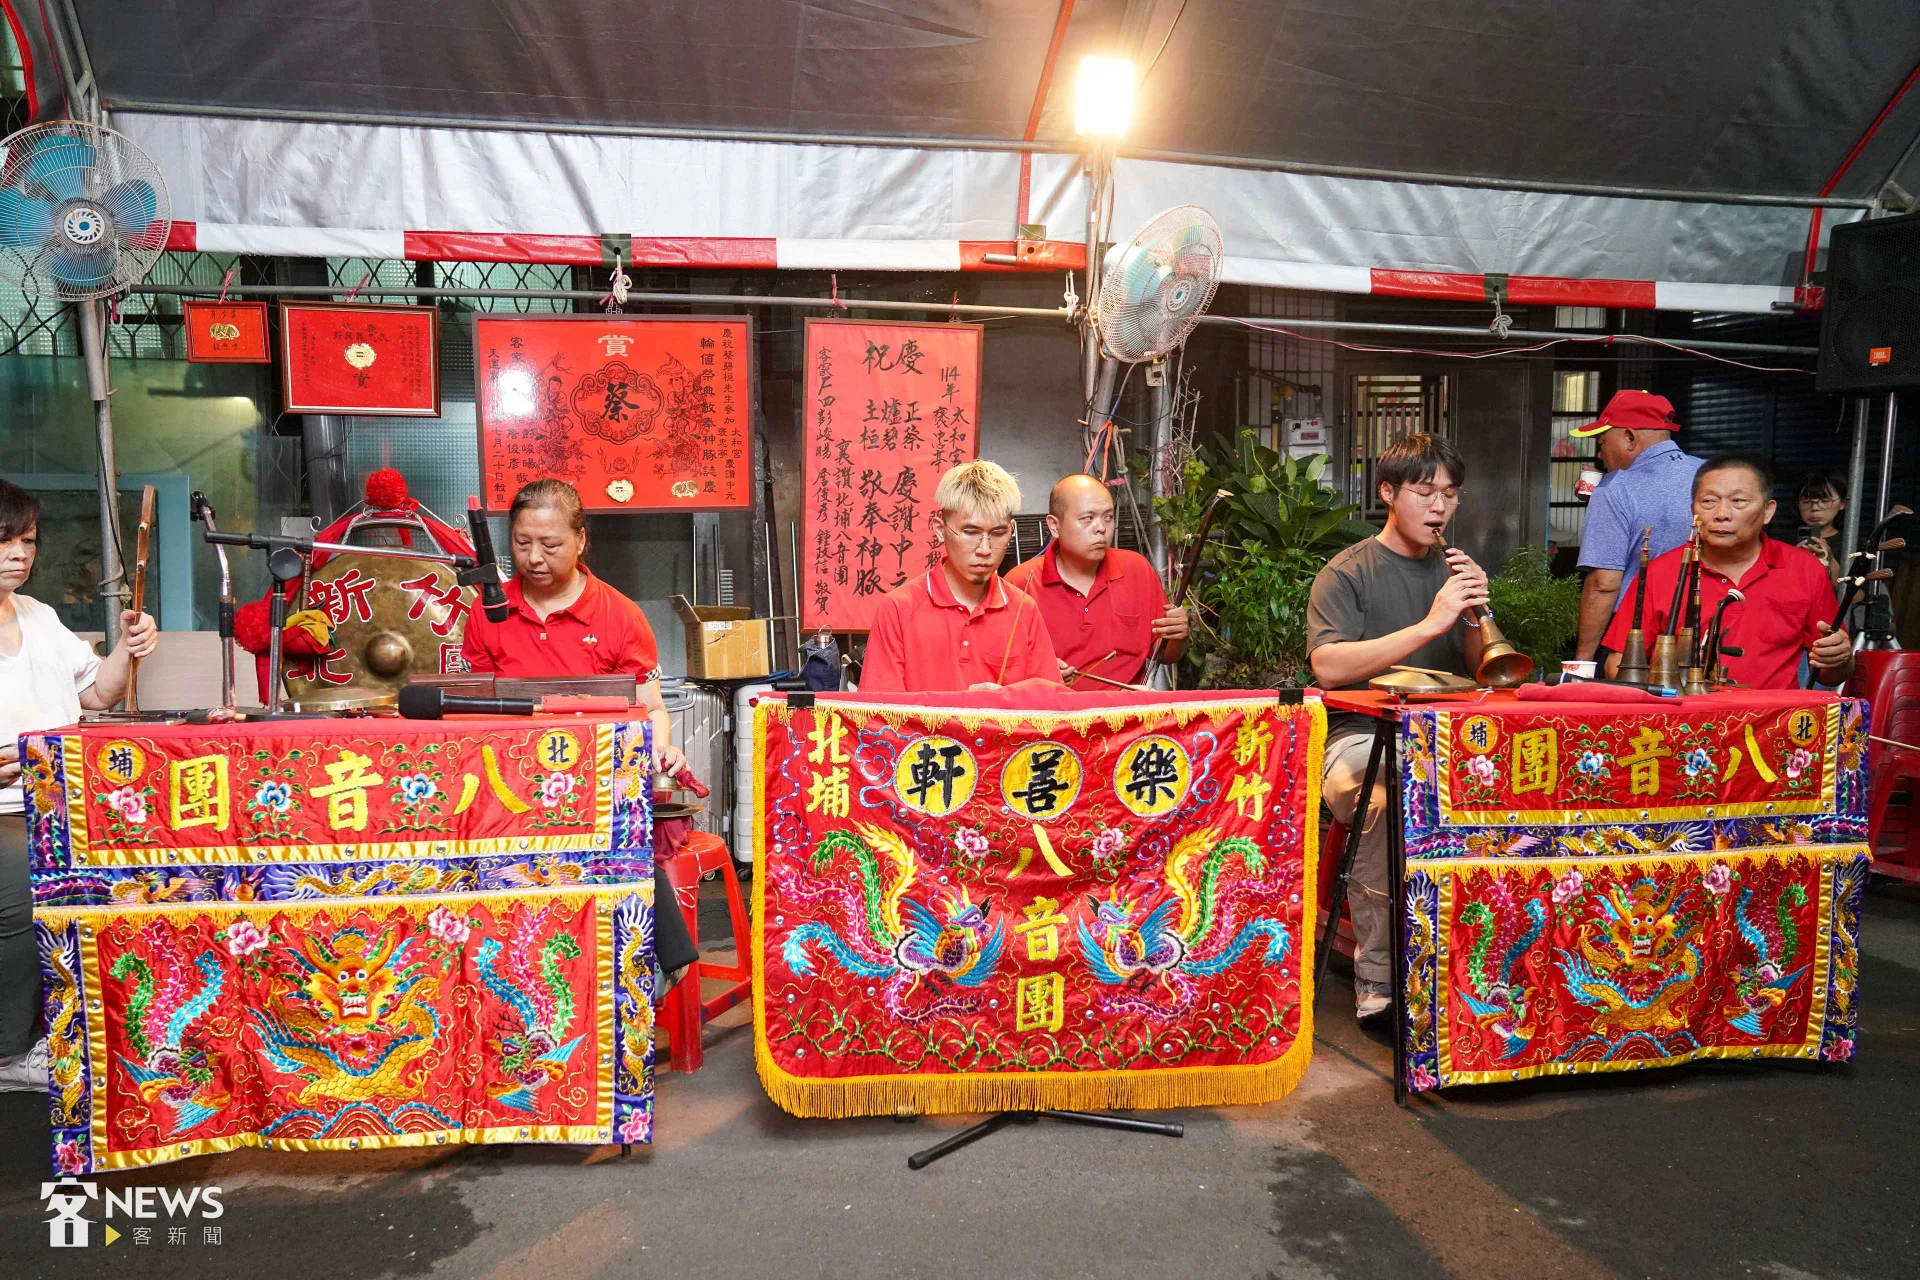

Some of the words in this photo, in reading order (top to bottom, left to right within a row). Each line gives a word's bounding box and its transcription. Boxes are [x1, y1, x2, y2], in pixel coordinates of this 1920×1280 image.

[598, 335, 635, 357] 賞
[861, 339, 926, 375] 慶祝
[602, 380, 640, 424] 蔡
[1467, 719, 1489, 749] 埔
[1796, 714, 1813, 742] 北
[107, 747, 134, 778] 埔
[546, 735, 570, 764] 北
[807, 713, 852, 819] 北埔
[904, 740, 1180, 815] 樂善軒
[1225, 719, 1276, 823] 新竹
[1007, 823, 1075, 1036] 八音團
